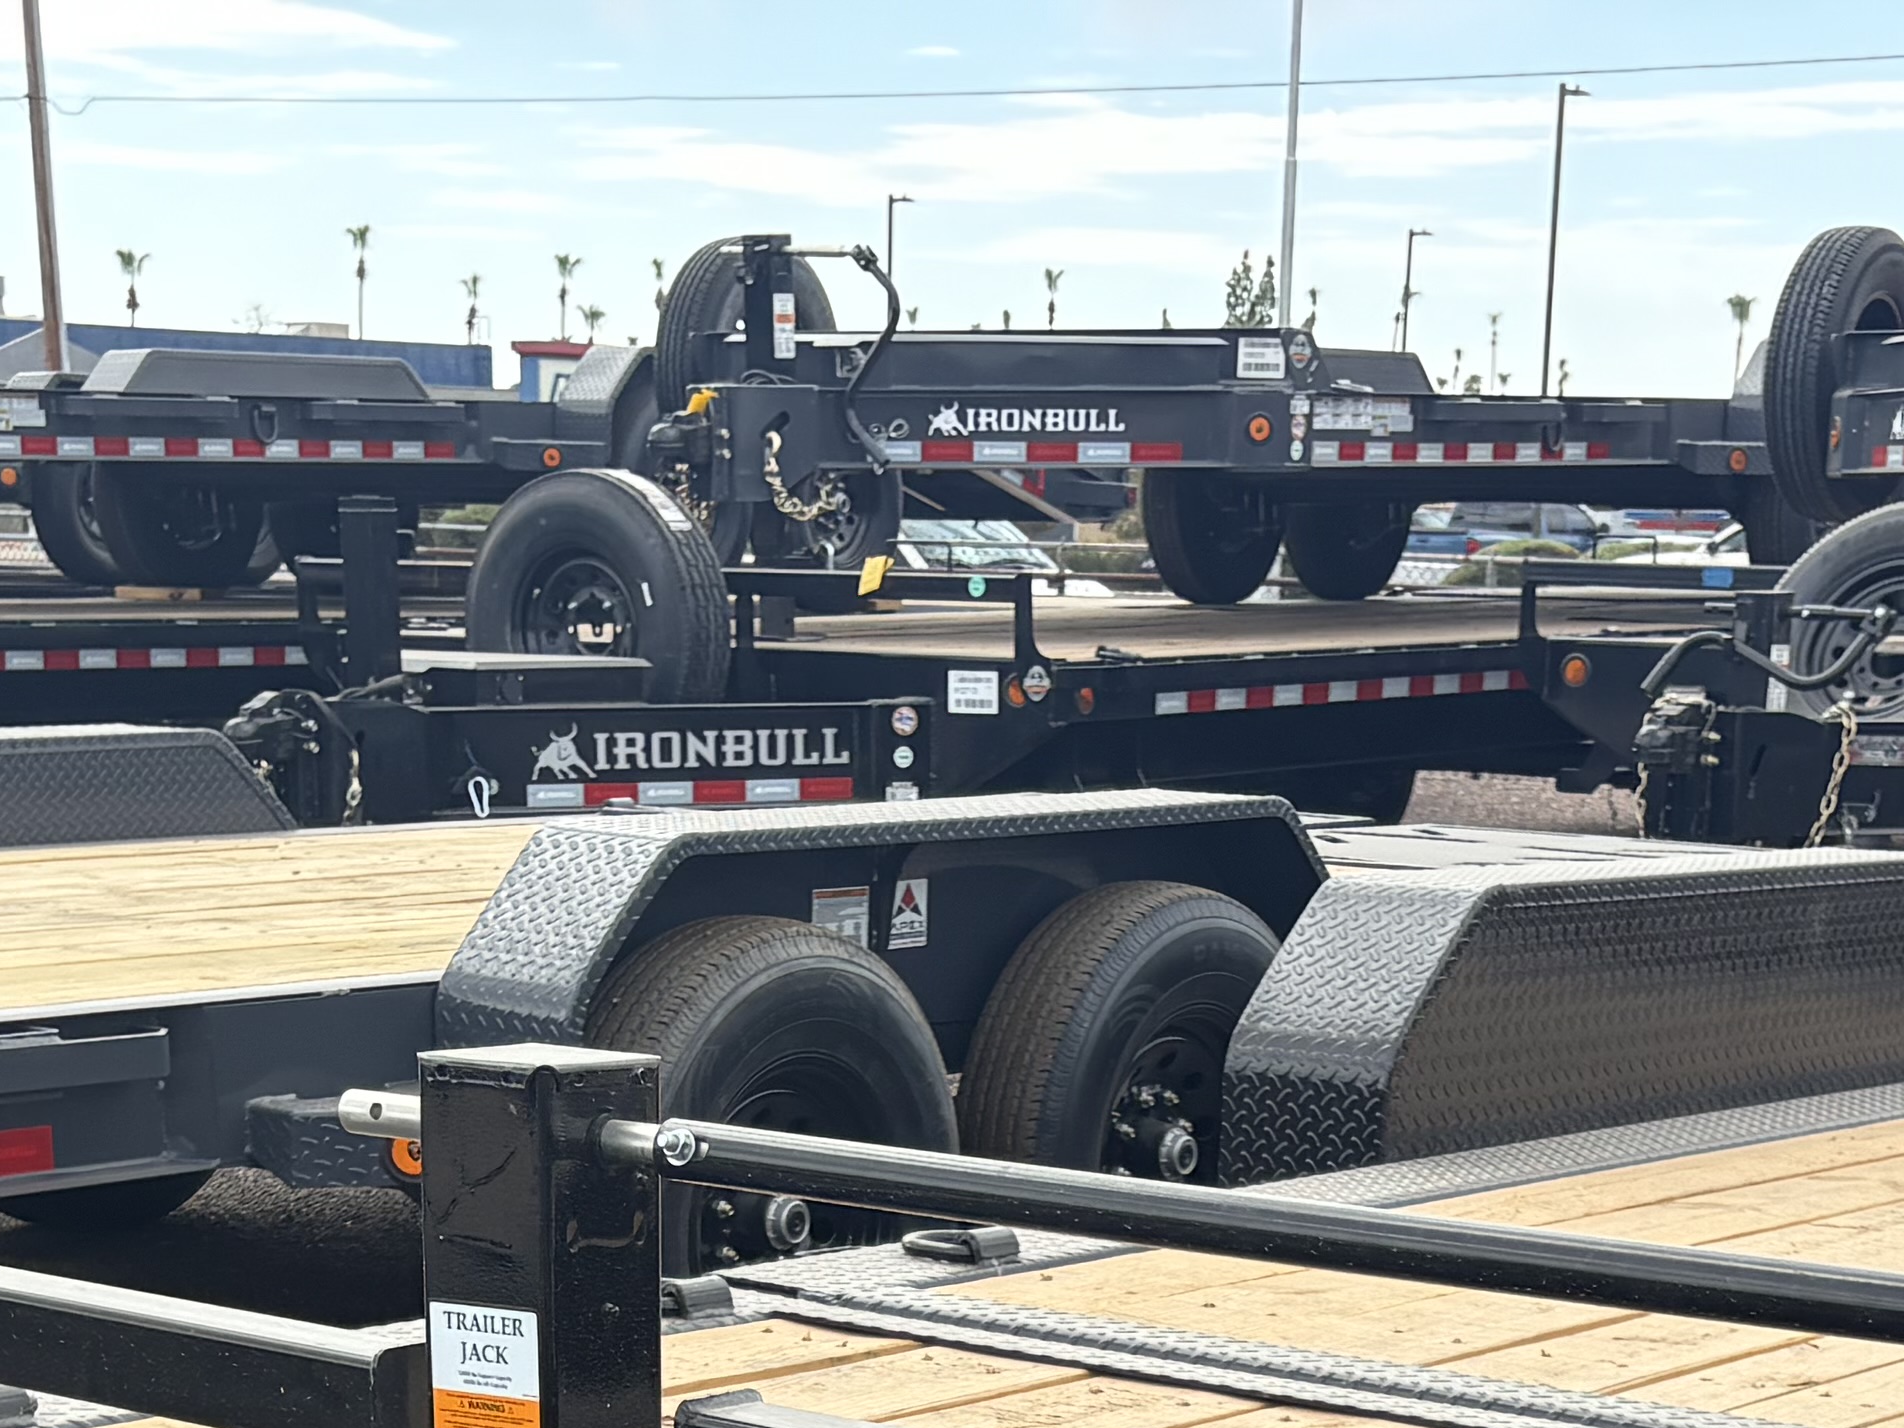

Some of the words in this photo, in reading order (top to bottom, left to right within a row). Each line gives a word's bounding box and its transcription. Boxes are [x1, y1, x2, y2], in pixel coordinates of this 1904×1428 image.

[966, 408, 1126, 432] IRONBULL
[592, 728, 851, 770] IRONBULL
[443, 1311, 524, 1337] TRAILER
[460, 1341, 509, 1365] JACK
